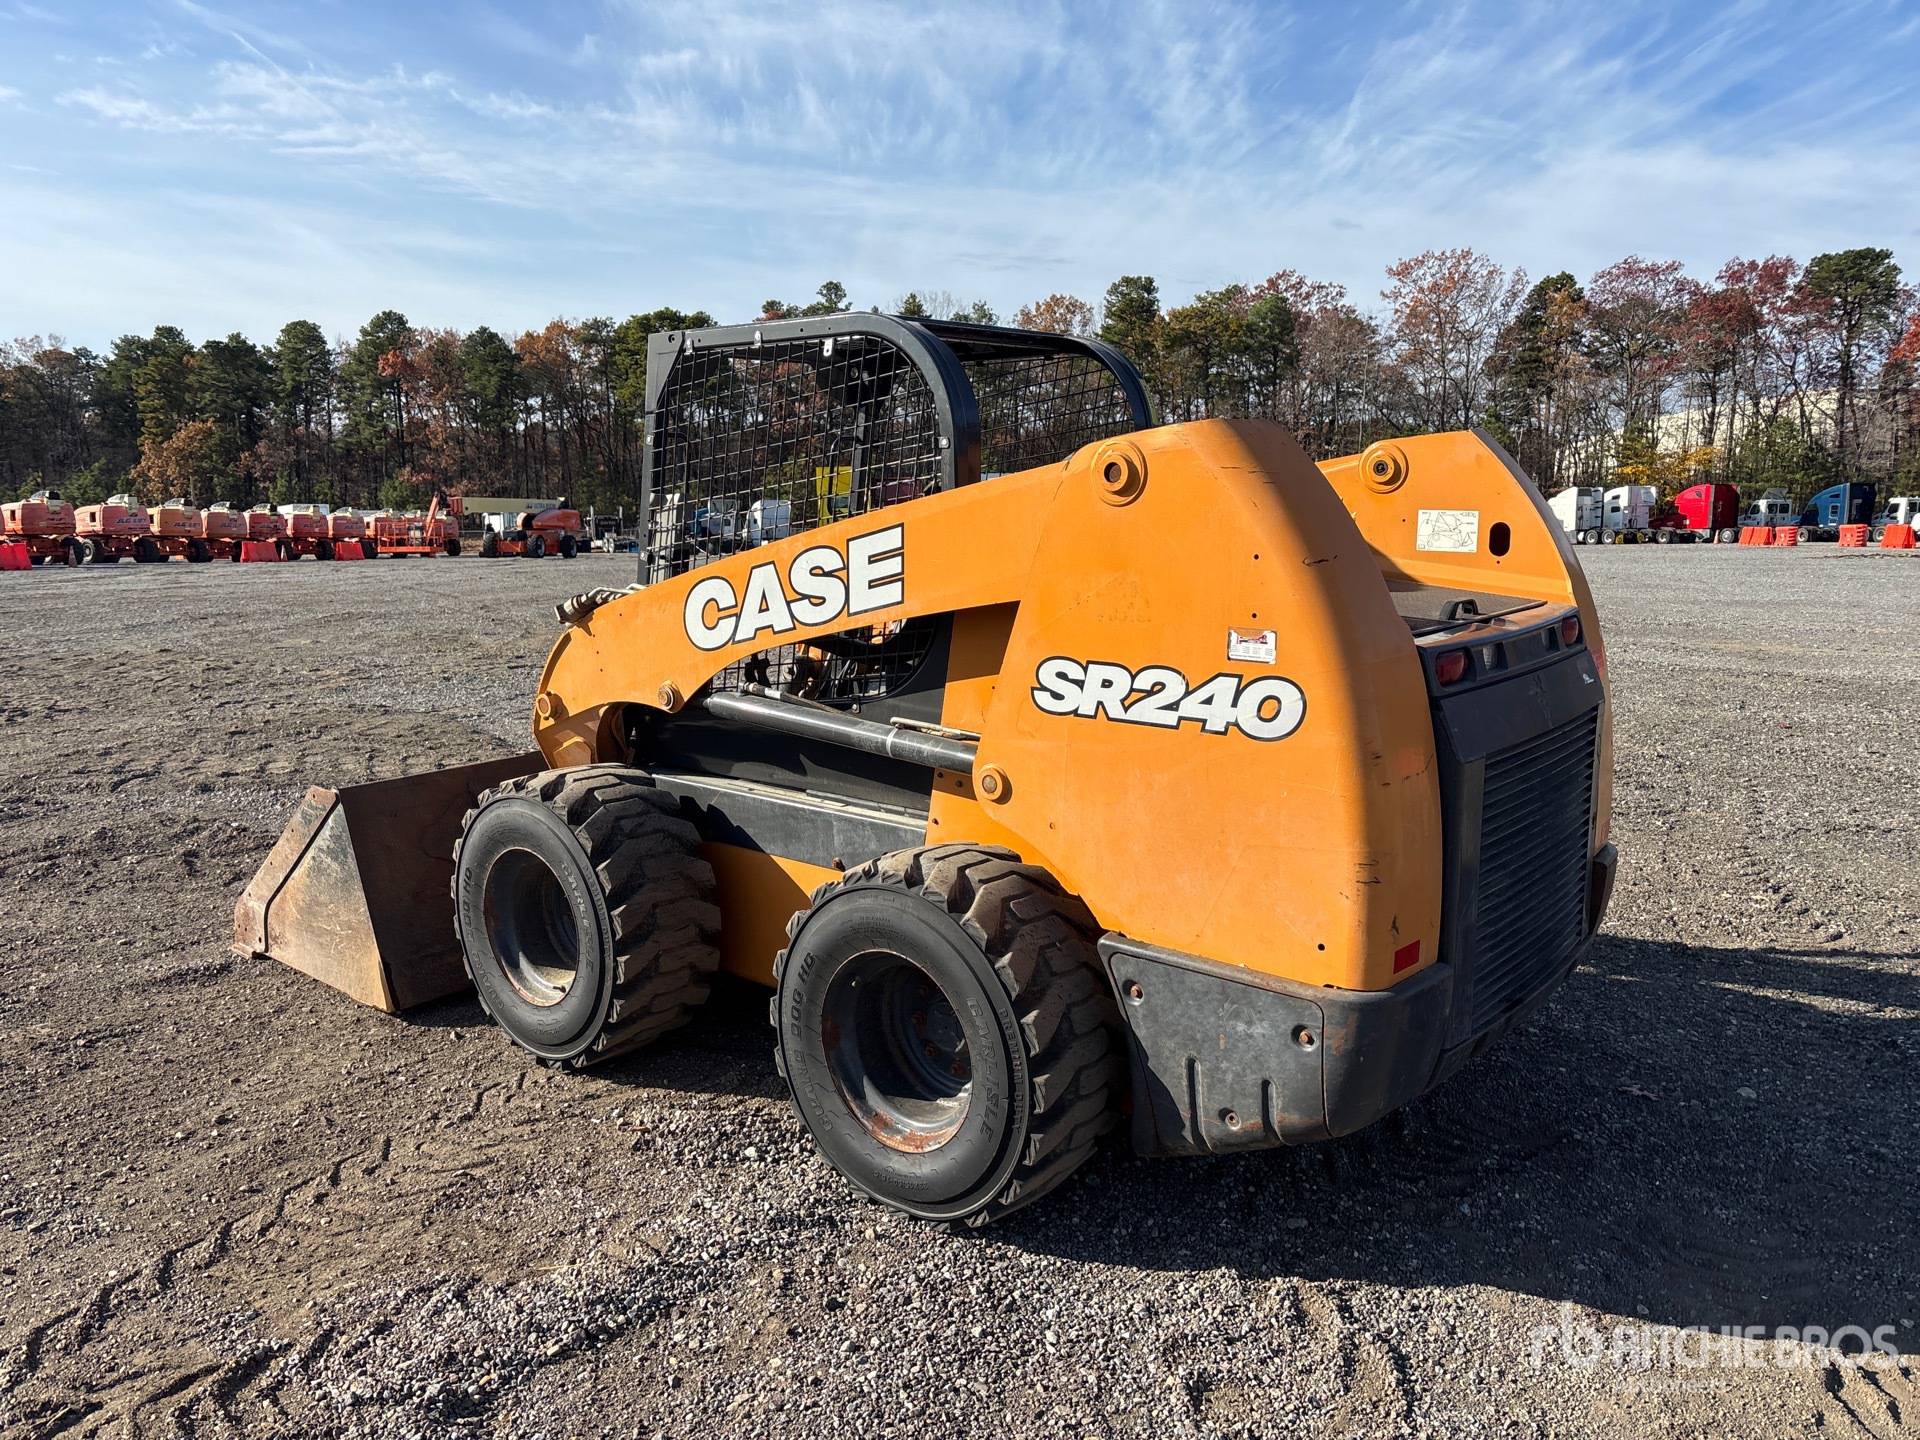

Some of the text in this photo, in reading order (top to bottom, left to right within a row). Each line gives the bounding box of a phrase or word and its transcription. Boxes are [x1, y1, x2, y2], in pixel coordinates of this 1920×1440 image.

[683, 522, 904, 651] CASE
[1031, 655, 1307, 742] SR240
[463, 866, 473, 894] HD
[797, 952, 816, 984] HD
[791, 988, 805, 1041] DOG
[794, 1047, 833, 1132] GUARD
[966, 997, 1000, 1143] CARLISLE
[999, 1008, 1023, 1133] PREMIUM DUTY
